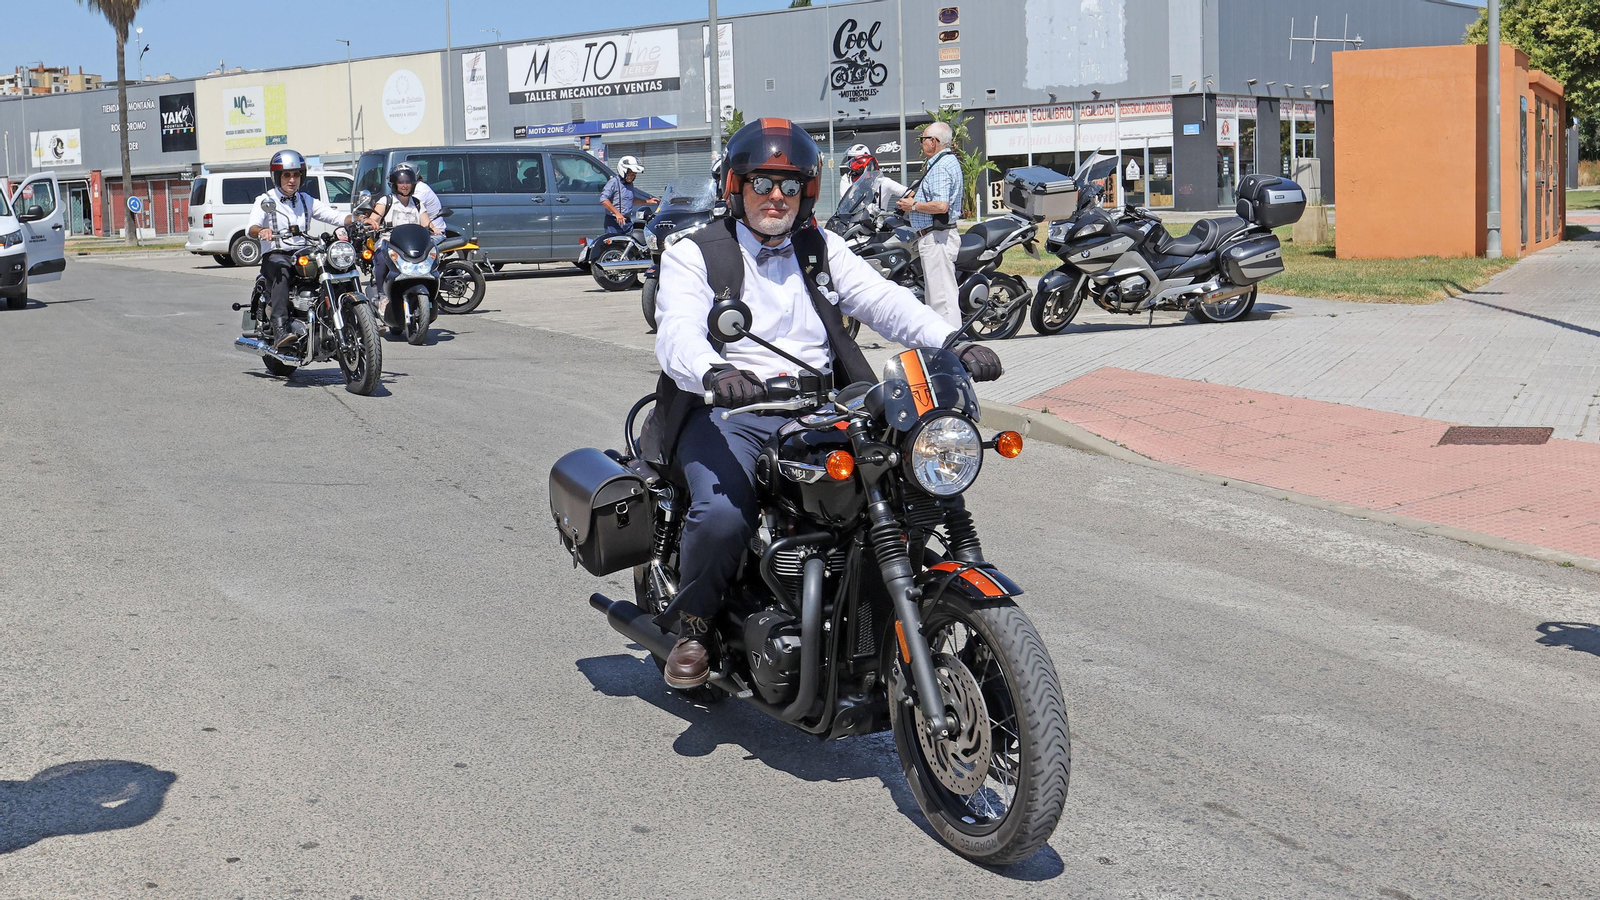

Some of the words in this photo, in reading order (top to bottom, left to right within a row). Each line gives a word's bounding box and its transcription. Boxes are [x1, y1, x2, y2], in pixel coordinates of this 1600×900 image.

[833, 18, 883, 59] Cool
[623, 64, 655, 77] JEREZ
[524, 90, 557, 102] TALLER
[559, 85, 612, 99] MECANICO
[615, 84, 621, 94] Y
[623, 80, 663, 93] VENTAS
[102, 104, 119, 113] TIENDA
[127, 99, 155, 111] MONTAÑA
[161, 111, 183, 124] YAK
[988, 109, 1027, 124] POTENCIA
[1031, 106, 1073, 121] EQUILIBRIO
[1080, 104, 1115, 117] AGILIDAD
[111, 121, 147, 132] ROCDROMO
[528, 127, 546, 135] MOTO
[547, 126, 565, 134] ZONE
[960, 837, 998, 852] ROADTEC
